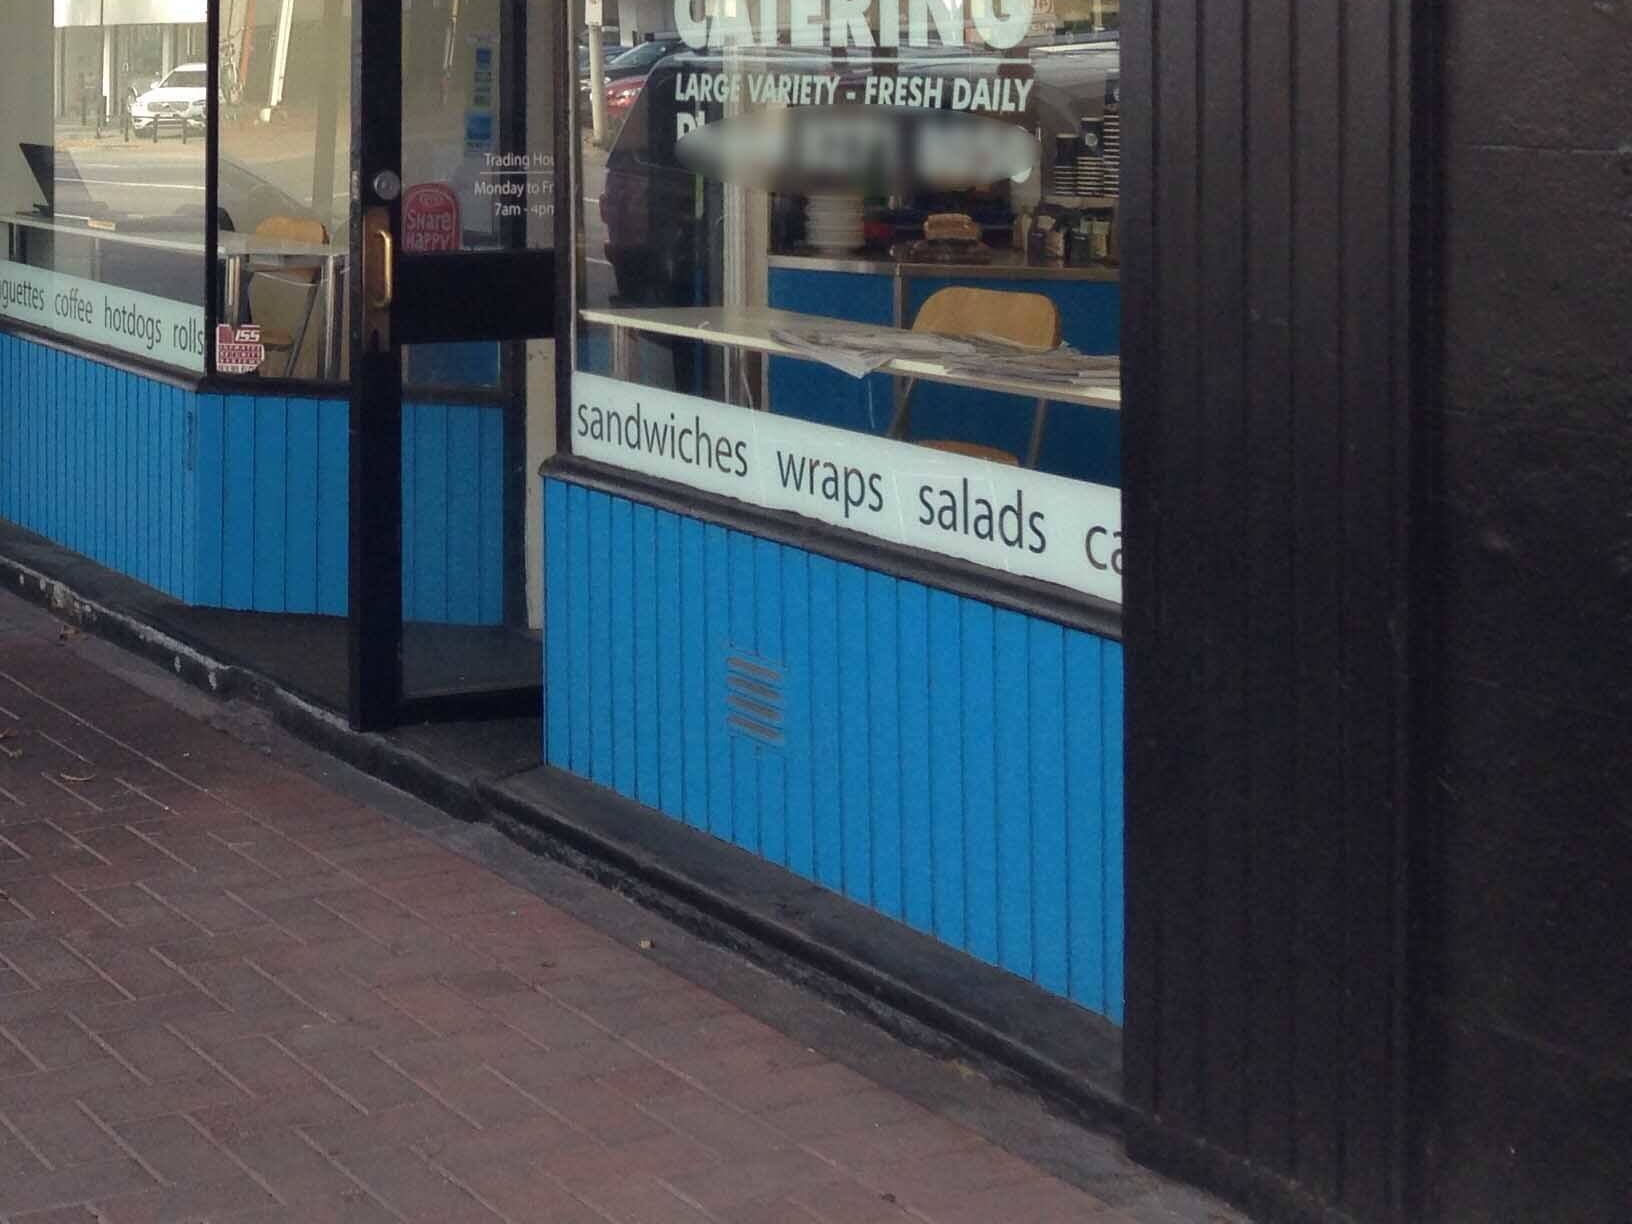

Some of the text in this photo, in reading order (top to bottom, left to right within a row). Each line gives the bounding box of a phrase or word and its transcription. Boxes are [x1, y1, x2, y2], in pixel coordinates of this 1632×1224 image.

[675, 72, 740, 103] LARGE
[747, 73, 841, 105] VARIETY
[865, 76, 943, 109] FRESH
[952, 78, 1034, 112] DAILY
[483, 152, 529, 170] Trading
[473, 180, 524, 197] Monday
[526, 181, 540, 195] to
[494, 203, 521, 216] 7am
[54, 287, 93, 325] coffee
[104, 296, 162, 350] hotdogs
[173, 317, 204, 356] rolls
[576, 401, 749, 477] sandwiches
[776, 448, 884, 519] wraps
[918, 478, 1047, 554] salads
